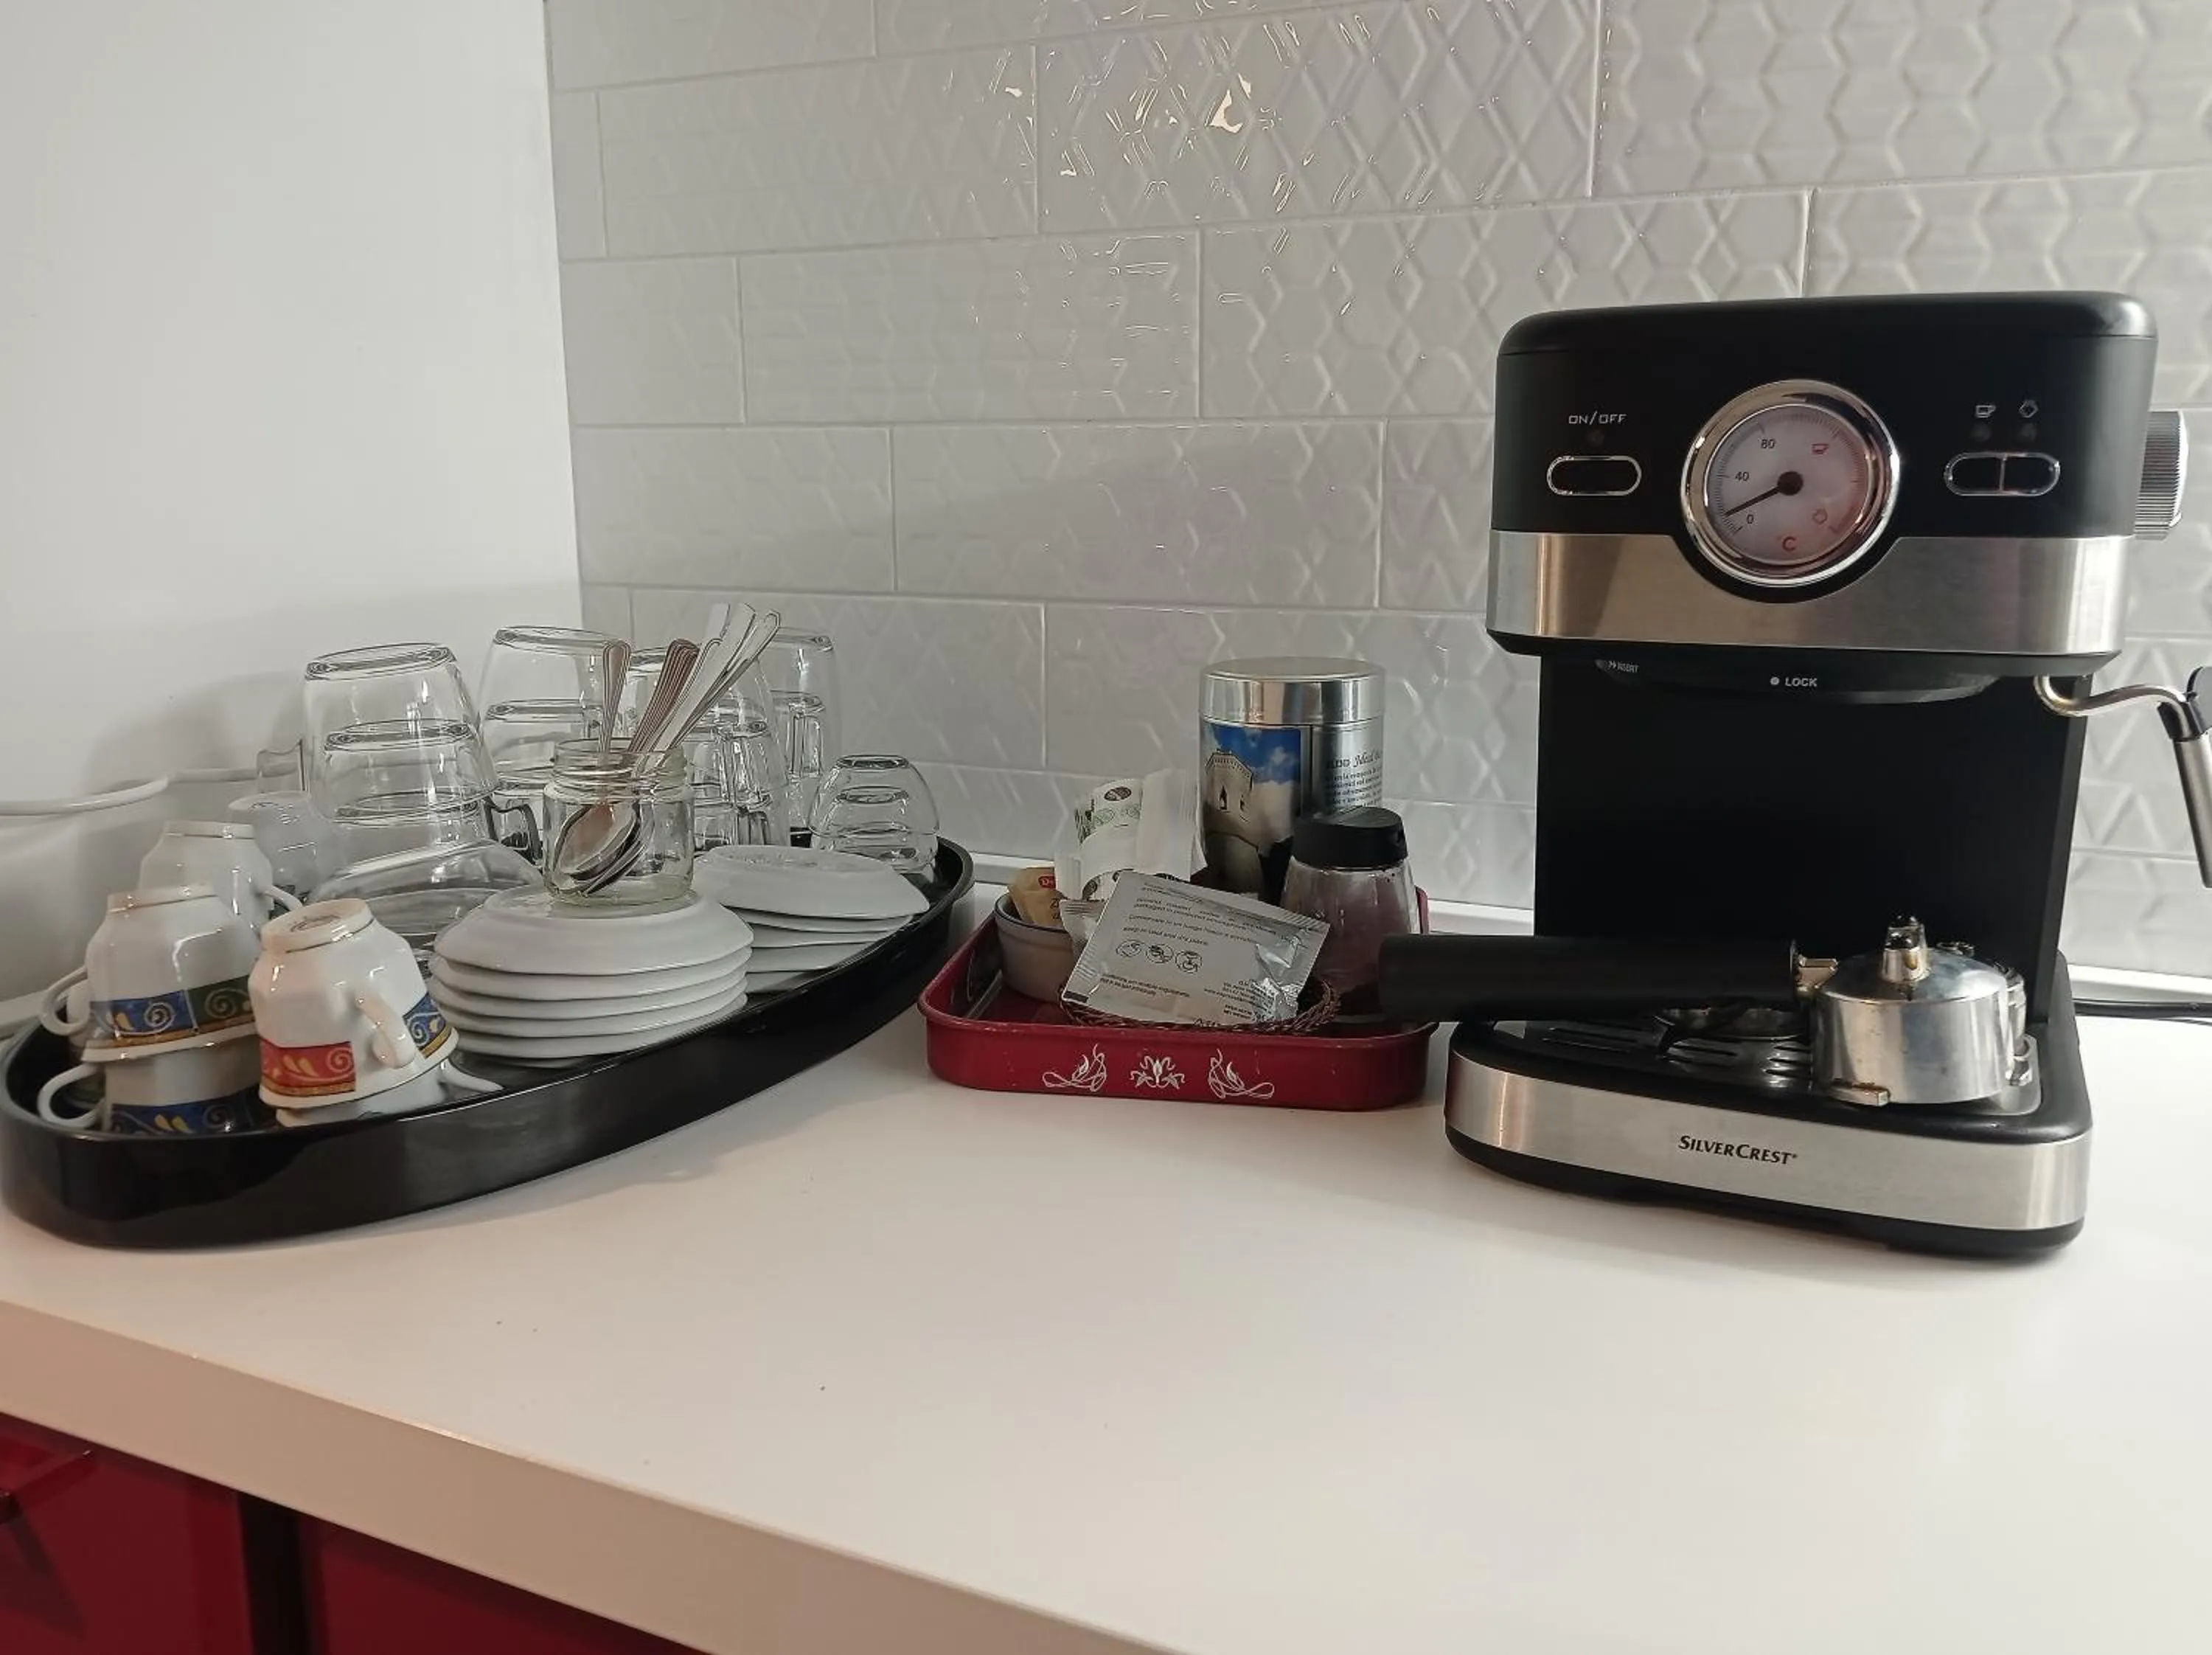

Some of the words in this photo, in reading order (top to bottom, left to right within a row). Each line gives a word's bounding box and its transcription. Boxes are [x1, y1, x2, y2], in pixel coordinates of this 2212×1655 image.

[1568, 410, 1627, 425] ON/OFF
[1760, 438, 1776, 450] 80
[1735, 471, 1750, 482] 40
[1746, 514, 1755, 524] 0
[1785, 677, 1818, 687] LOCK
